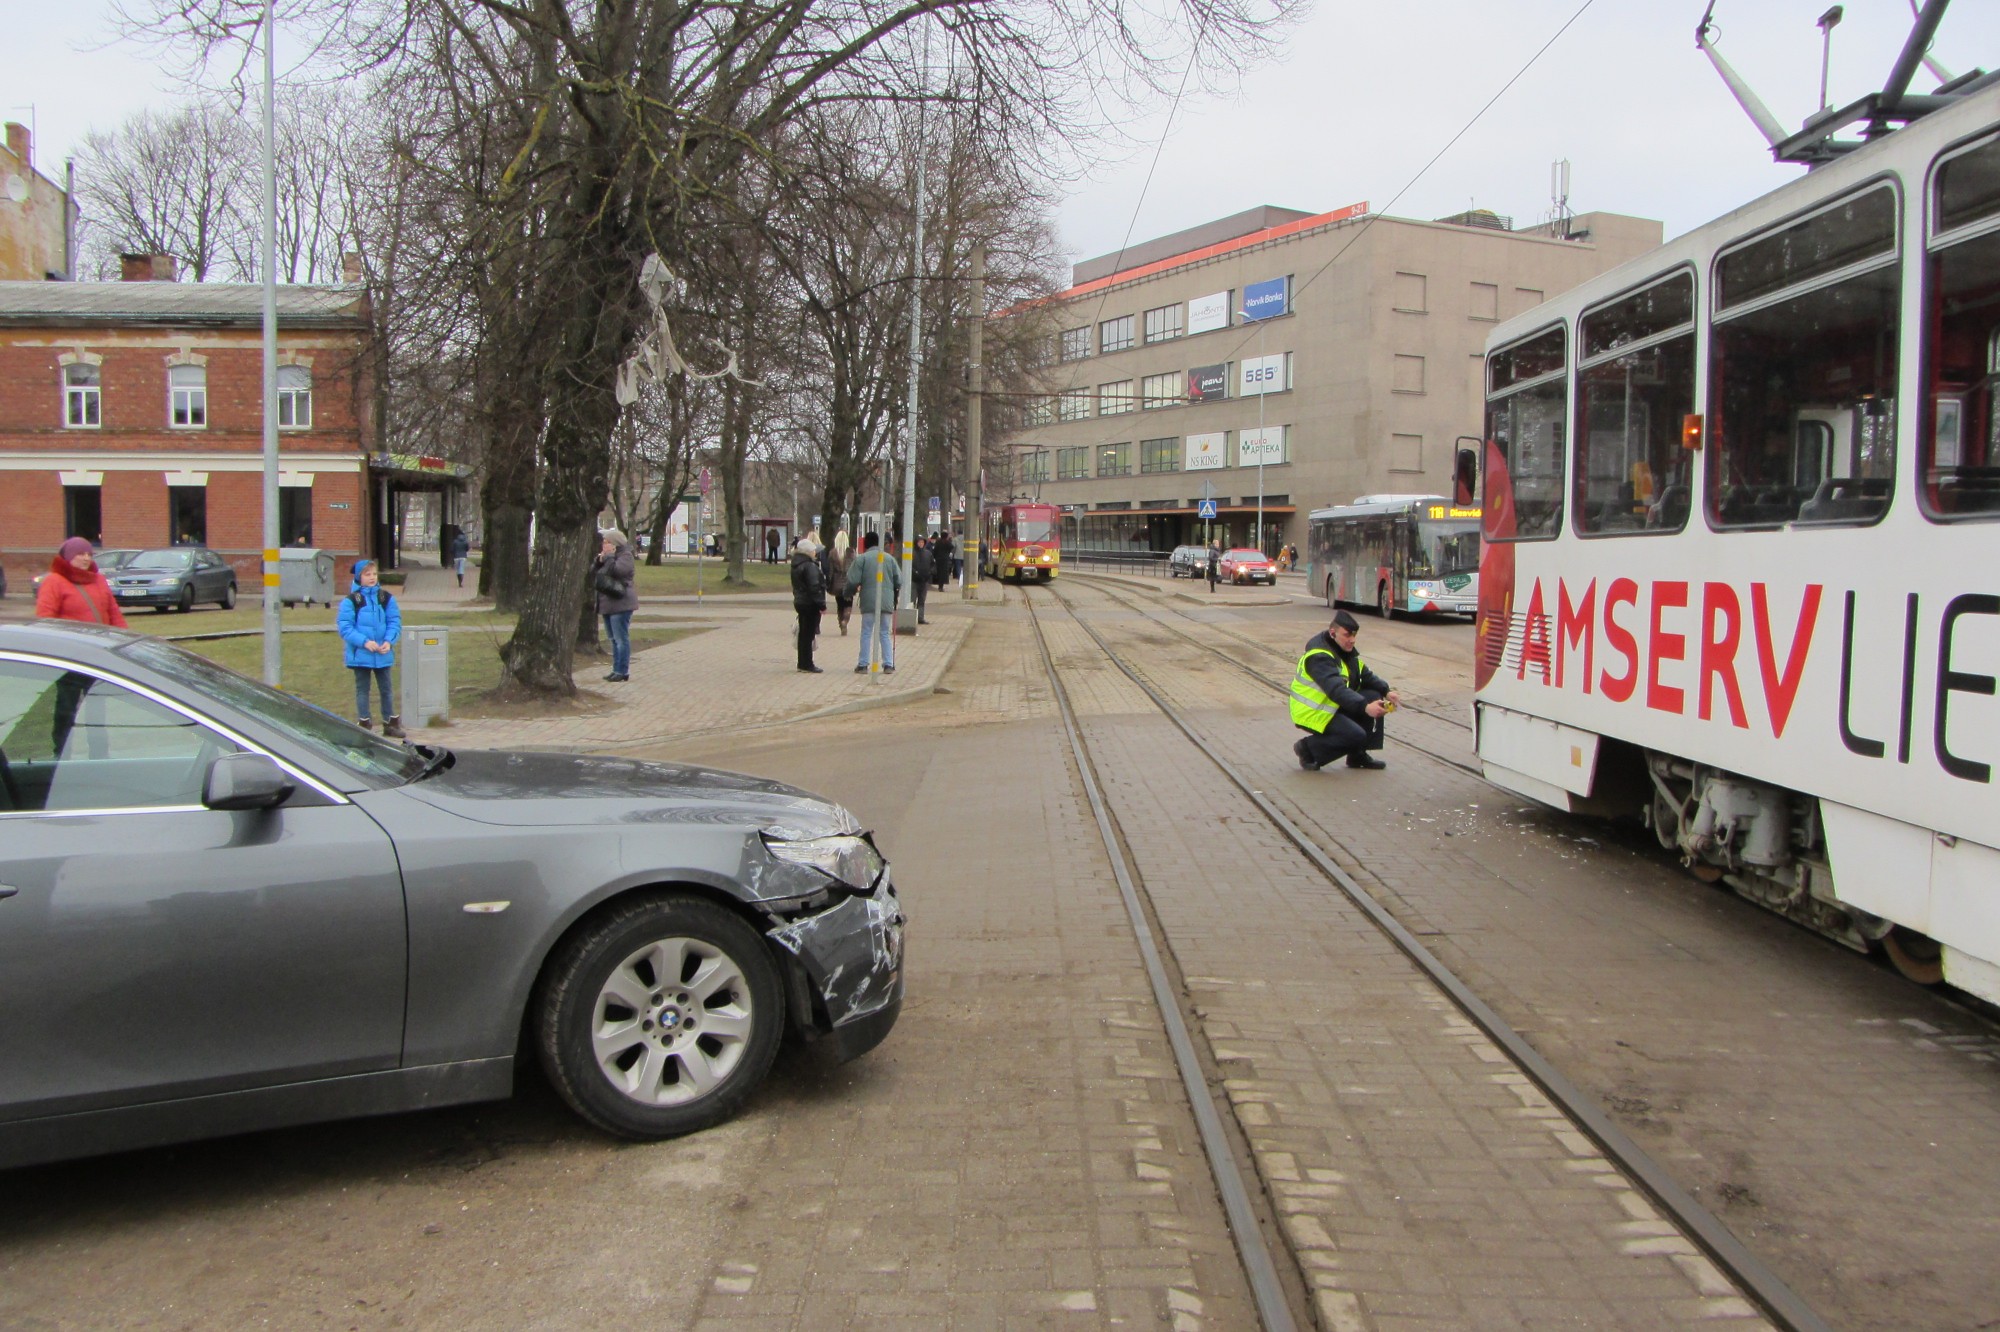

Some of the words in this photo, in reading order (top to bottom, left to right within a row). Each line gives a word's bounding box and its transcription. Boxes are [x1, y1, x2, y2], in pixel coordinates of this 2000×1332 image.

[1247, 296, 1264, 308] Norvik
[1265, 293, 1283, 304] Banka
[1190, 456, 1200, 467] NS
[1200, 454, 1218, 466] KING
[1516, 575, 1824, 740] AMSERV
